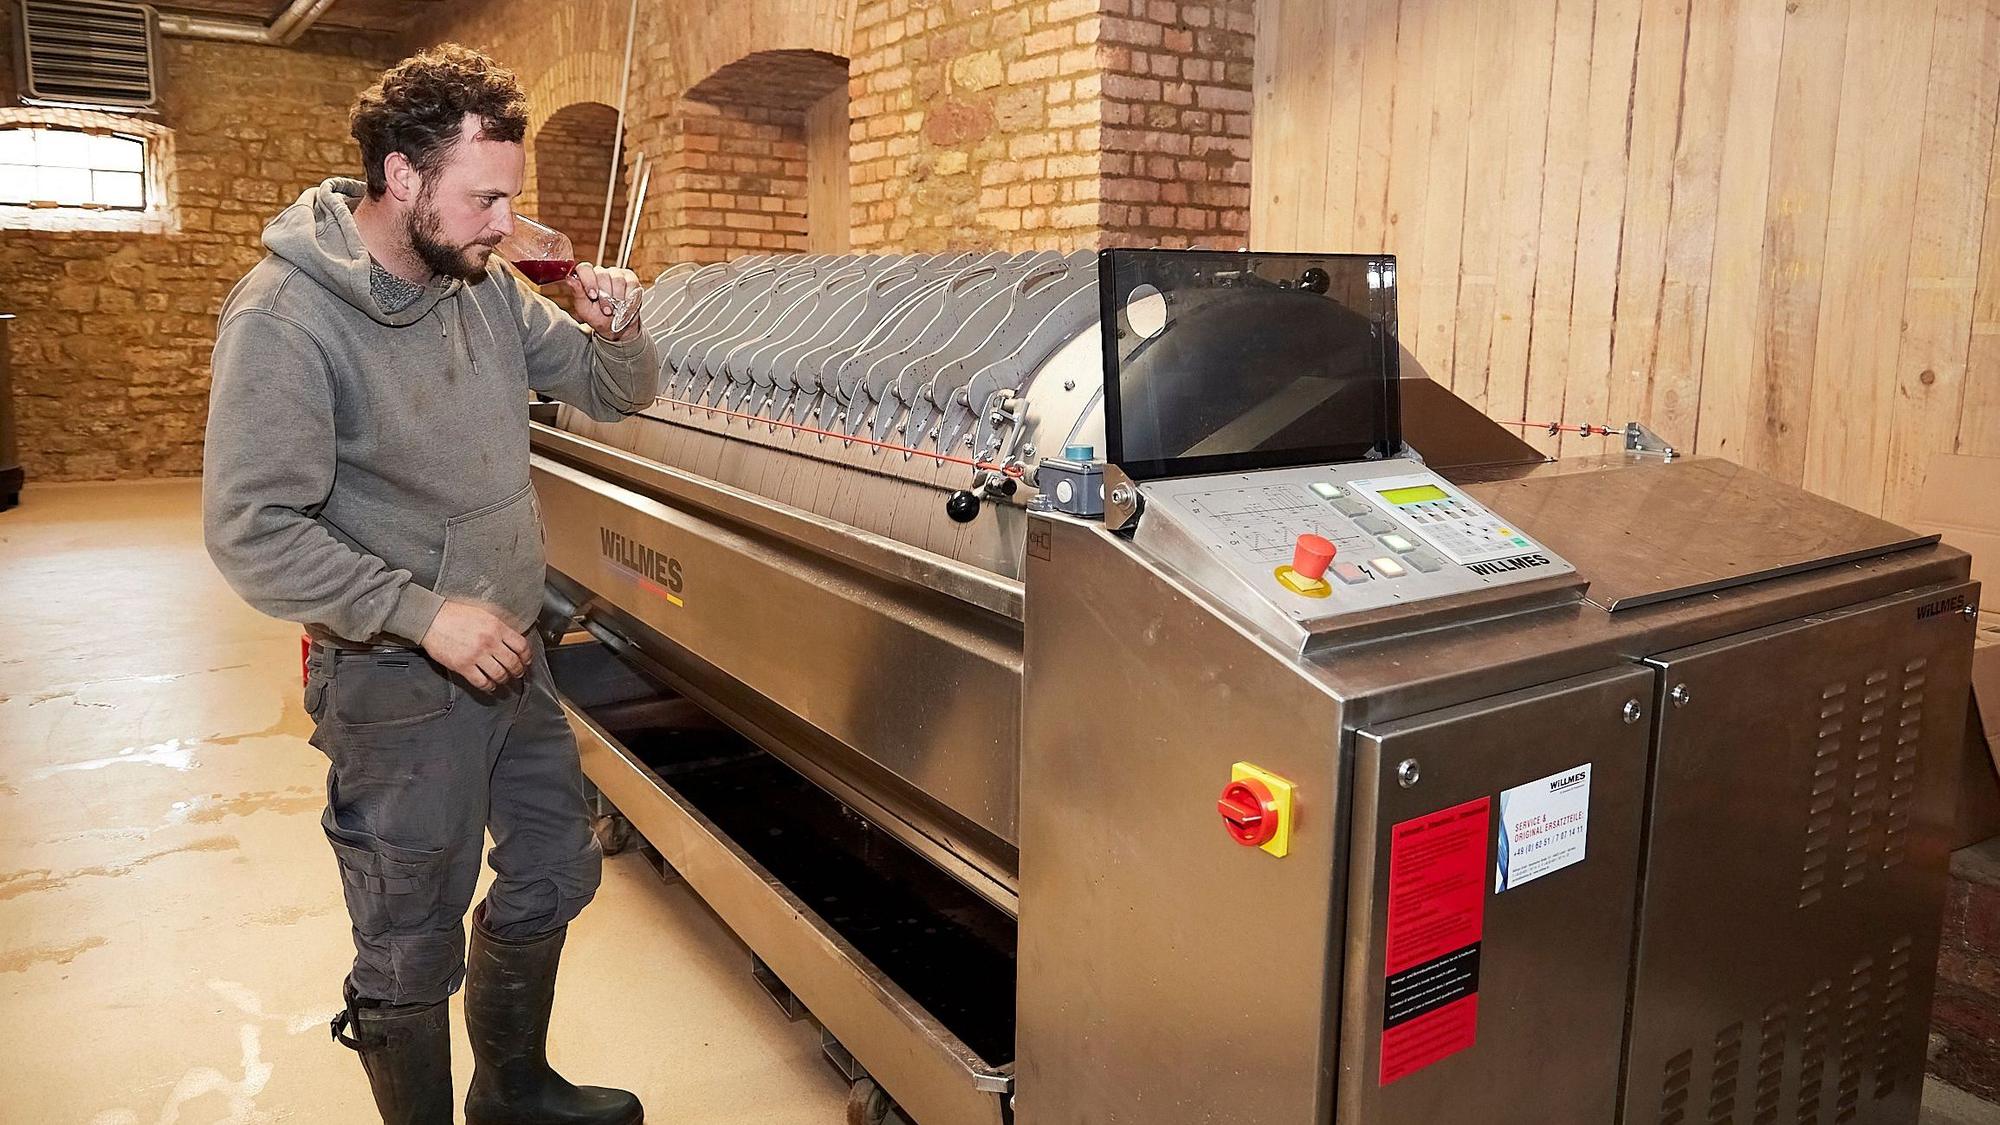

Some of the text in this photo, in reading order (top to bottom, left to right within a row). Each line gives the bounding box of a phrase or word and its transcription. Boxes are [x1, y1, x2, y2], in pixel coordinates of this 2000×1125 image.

[1514, 811, 1584, 843] ORIGINAL ERSATZTEILE:
[1515, 813, 1547, 832] SERVICE &
[1513, 847, 1524, 857] +49
[1525, 843, 1534, 855] (0)
[1544, 838, 1551, 847] 51
[1556, 833, 1560, 842] 7
[1569, 828, 1576, 837] 14
[1577, 825, 1583, 834] 11
